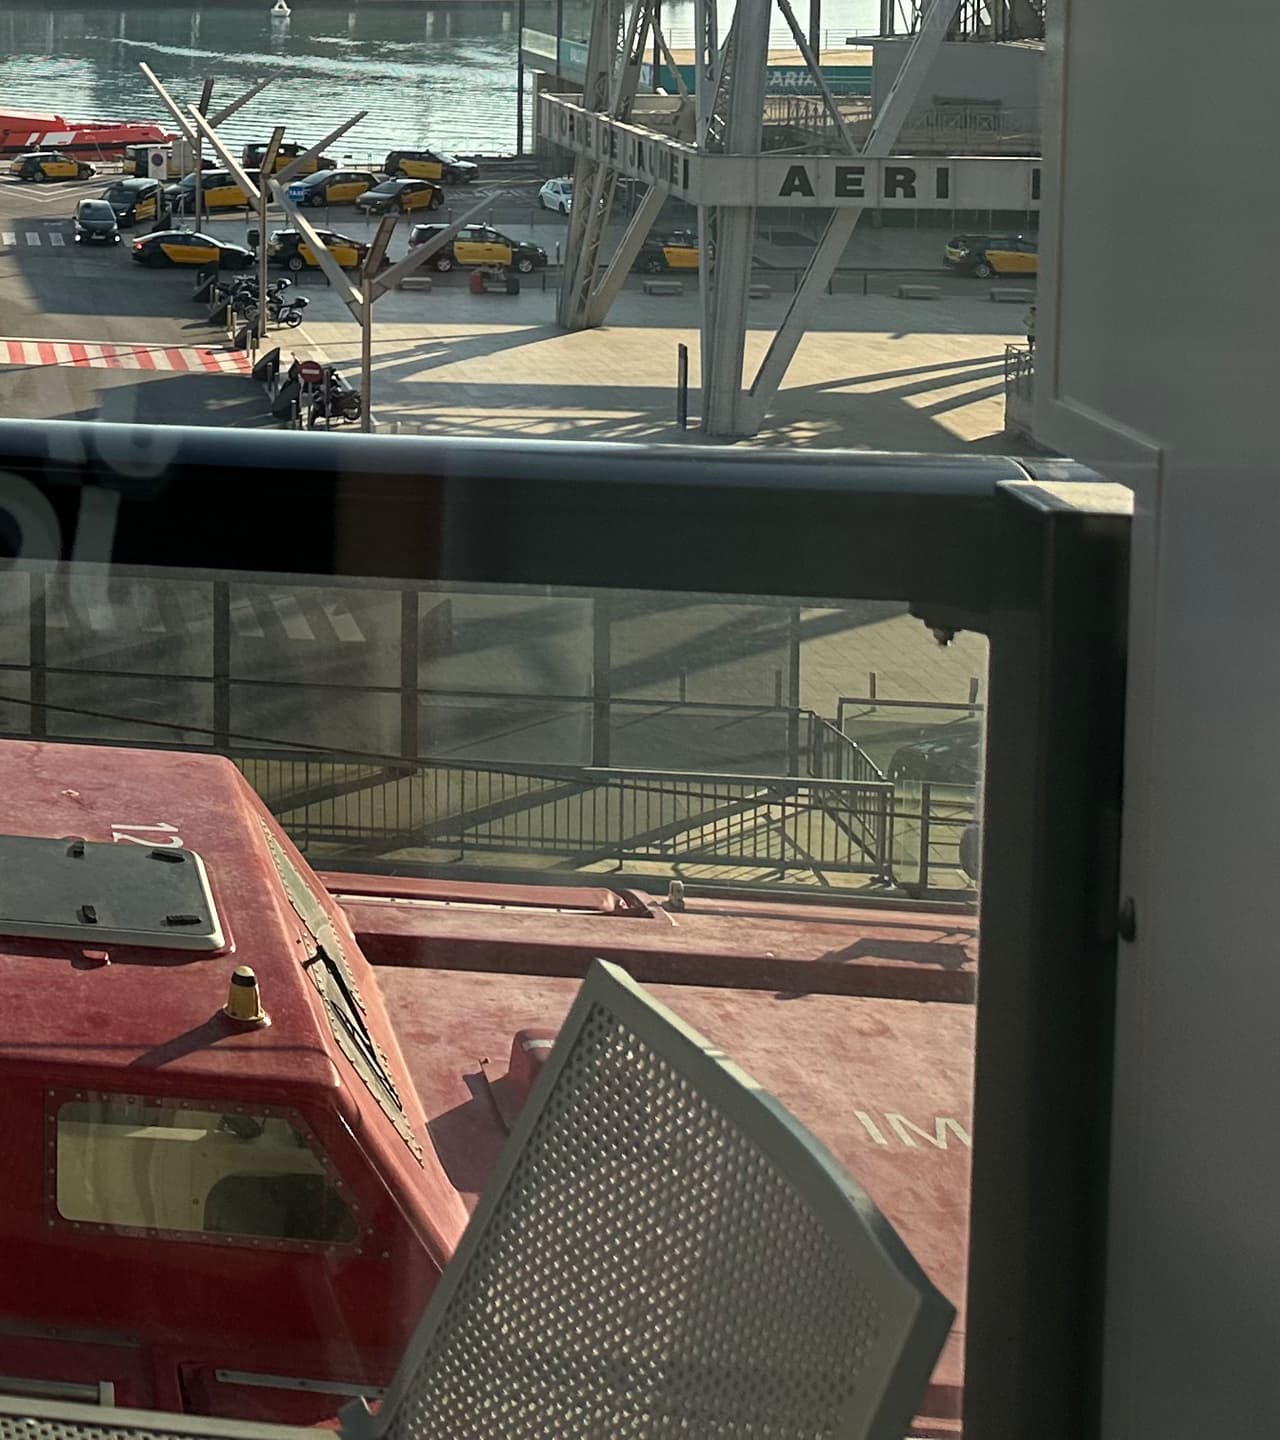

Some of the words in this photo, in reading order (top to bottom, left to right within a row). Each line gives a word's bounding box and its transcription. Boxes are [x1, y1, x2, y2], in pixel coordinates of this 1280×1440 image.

[767, 71, 817, 87] ARIA
[602, 126, 618, 160] DE
[629, 137, 679, 186] JAUME
[683, 158, 690, 190] I
[778, 164, 950, 200] AERI
